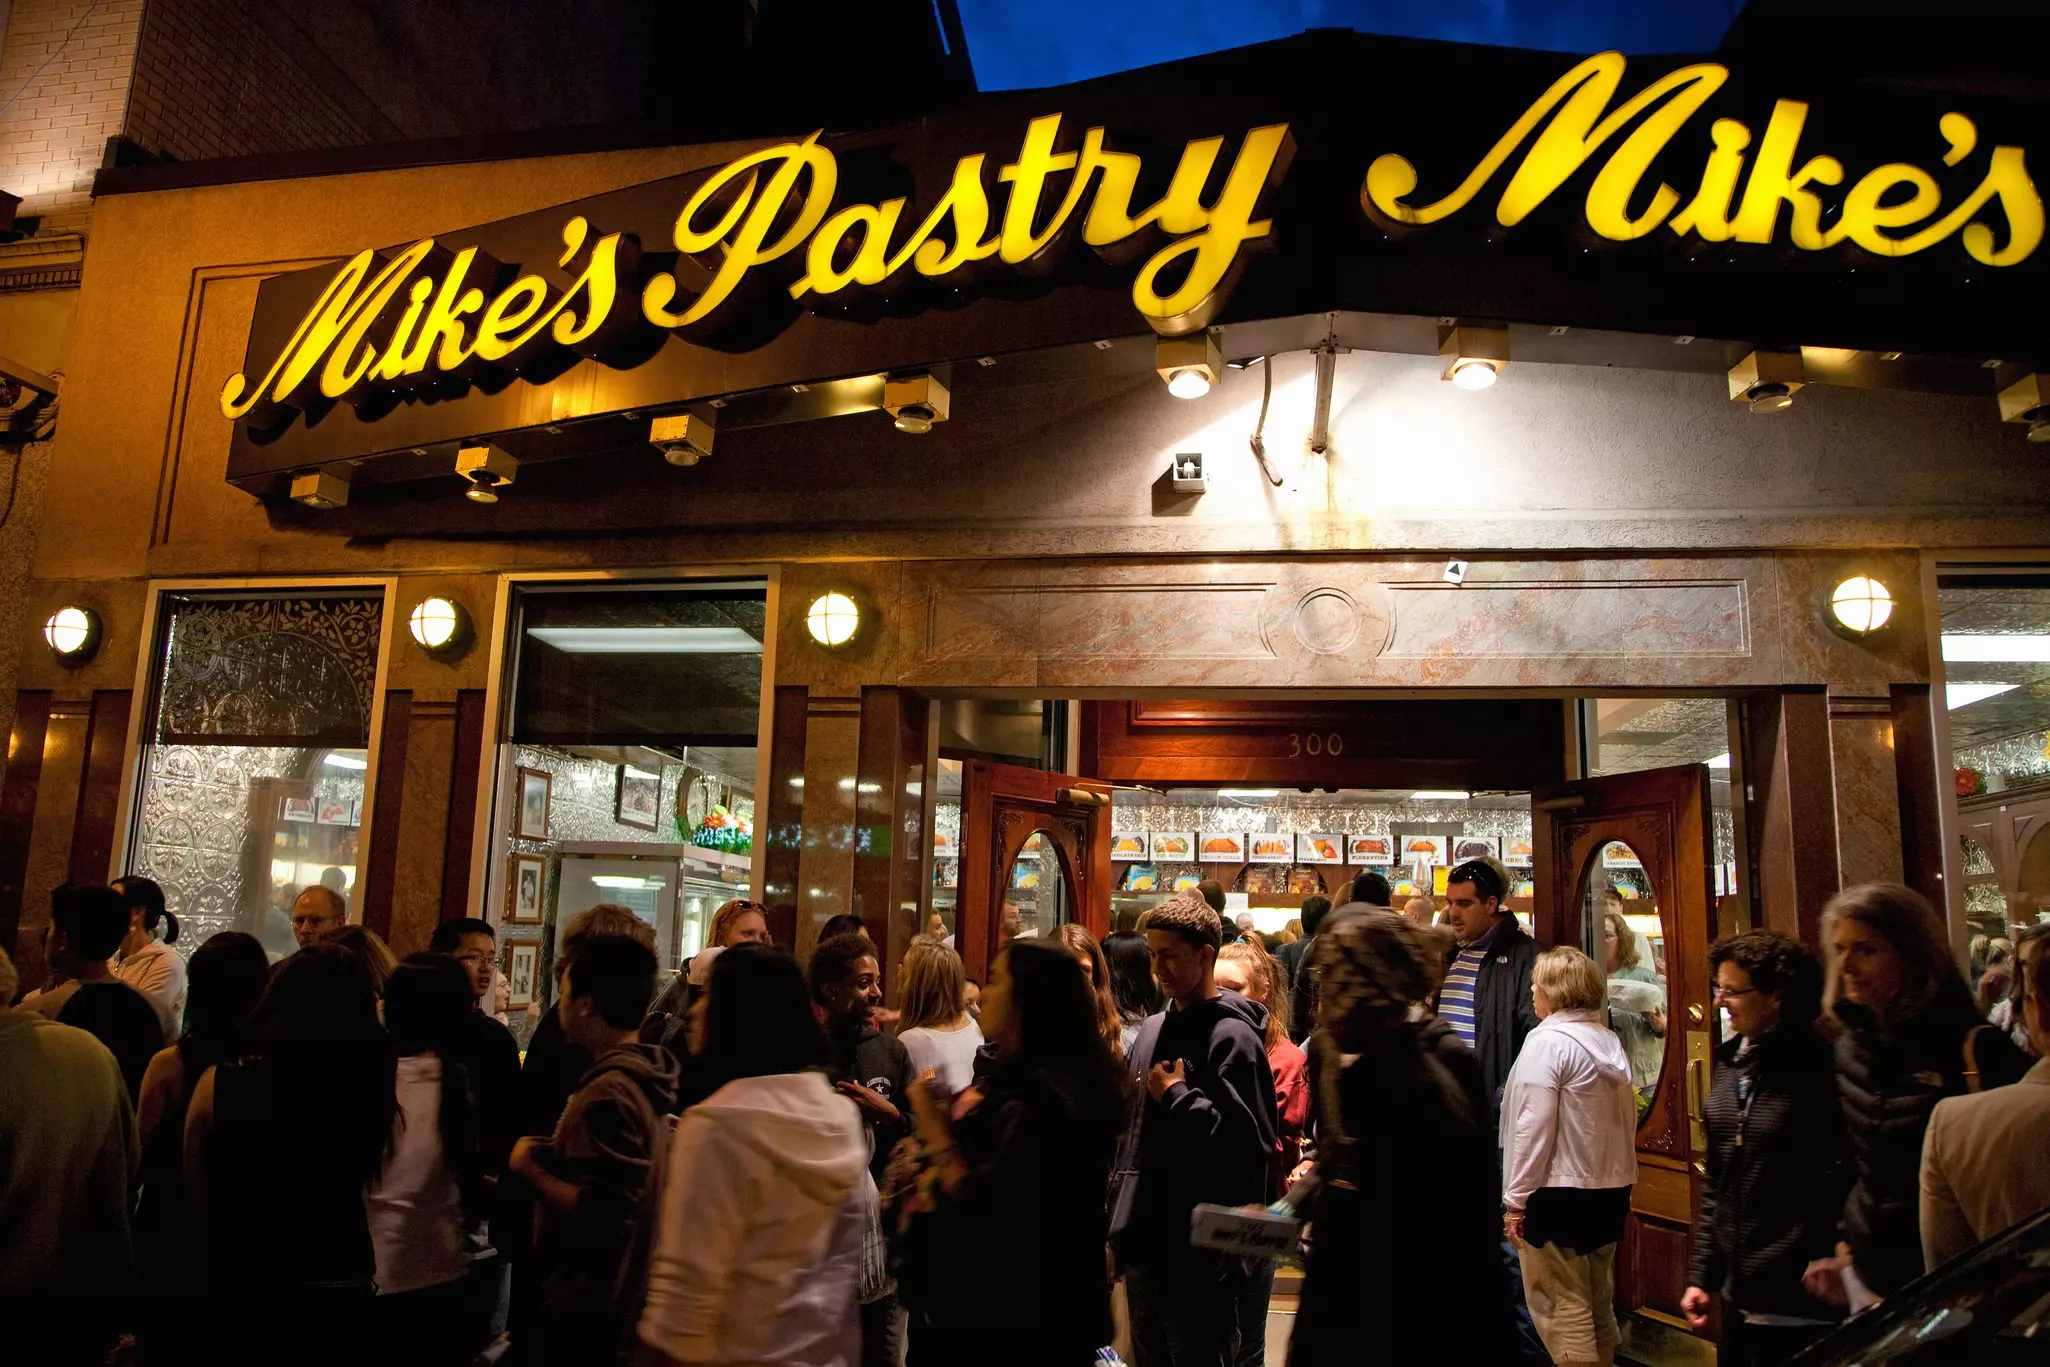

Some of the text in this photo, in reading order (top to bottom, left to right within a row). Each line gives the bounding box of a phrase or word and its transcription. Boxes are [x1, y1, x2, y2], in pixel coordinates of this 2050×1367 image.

[220, 111, 1291, 421] Mike's Pastry
[1364, 48, 2046, 267] Mike's
[1288, 732, 1344, 758] 300
